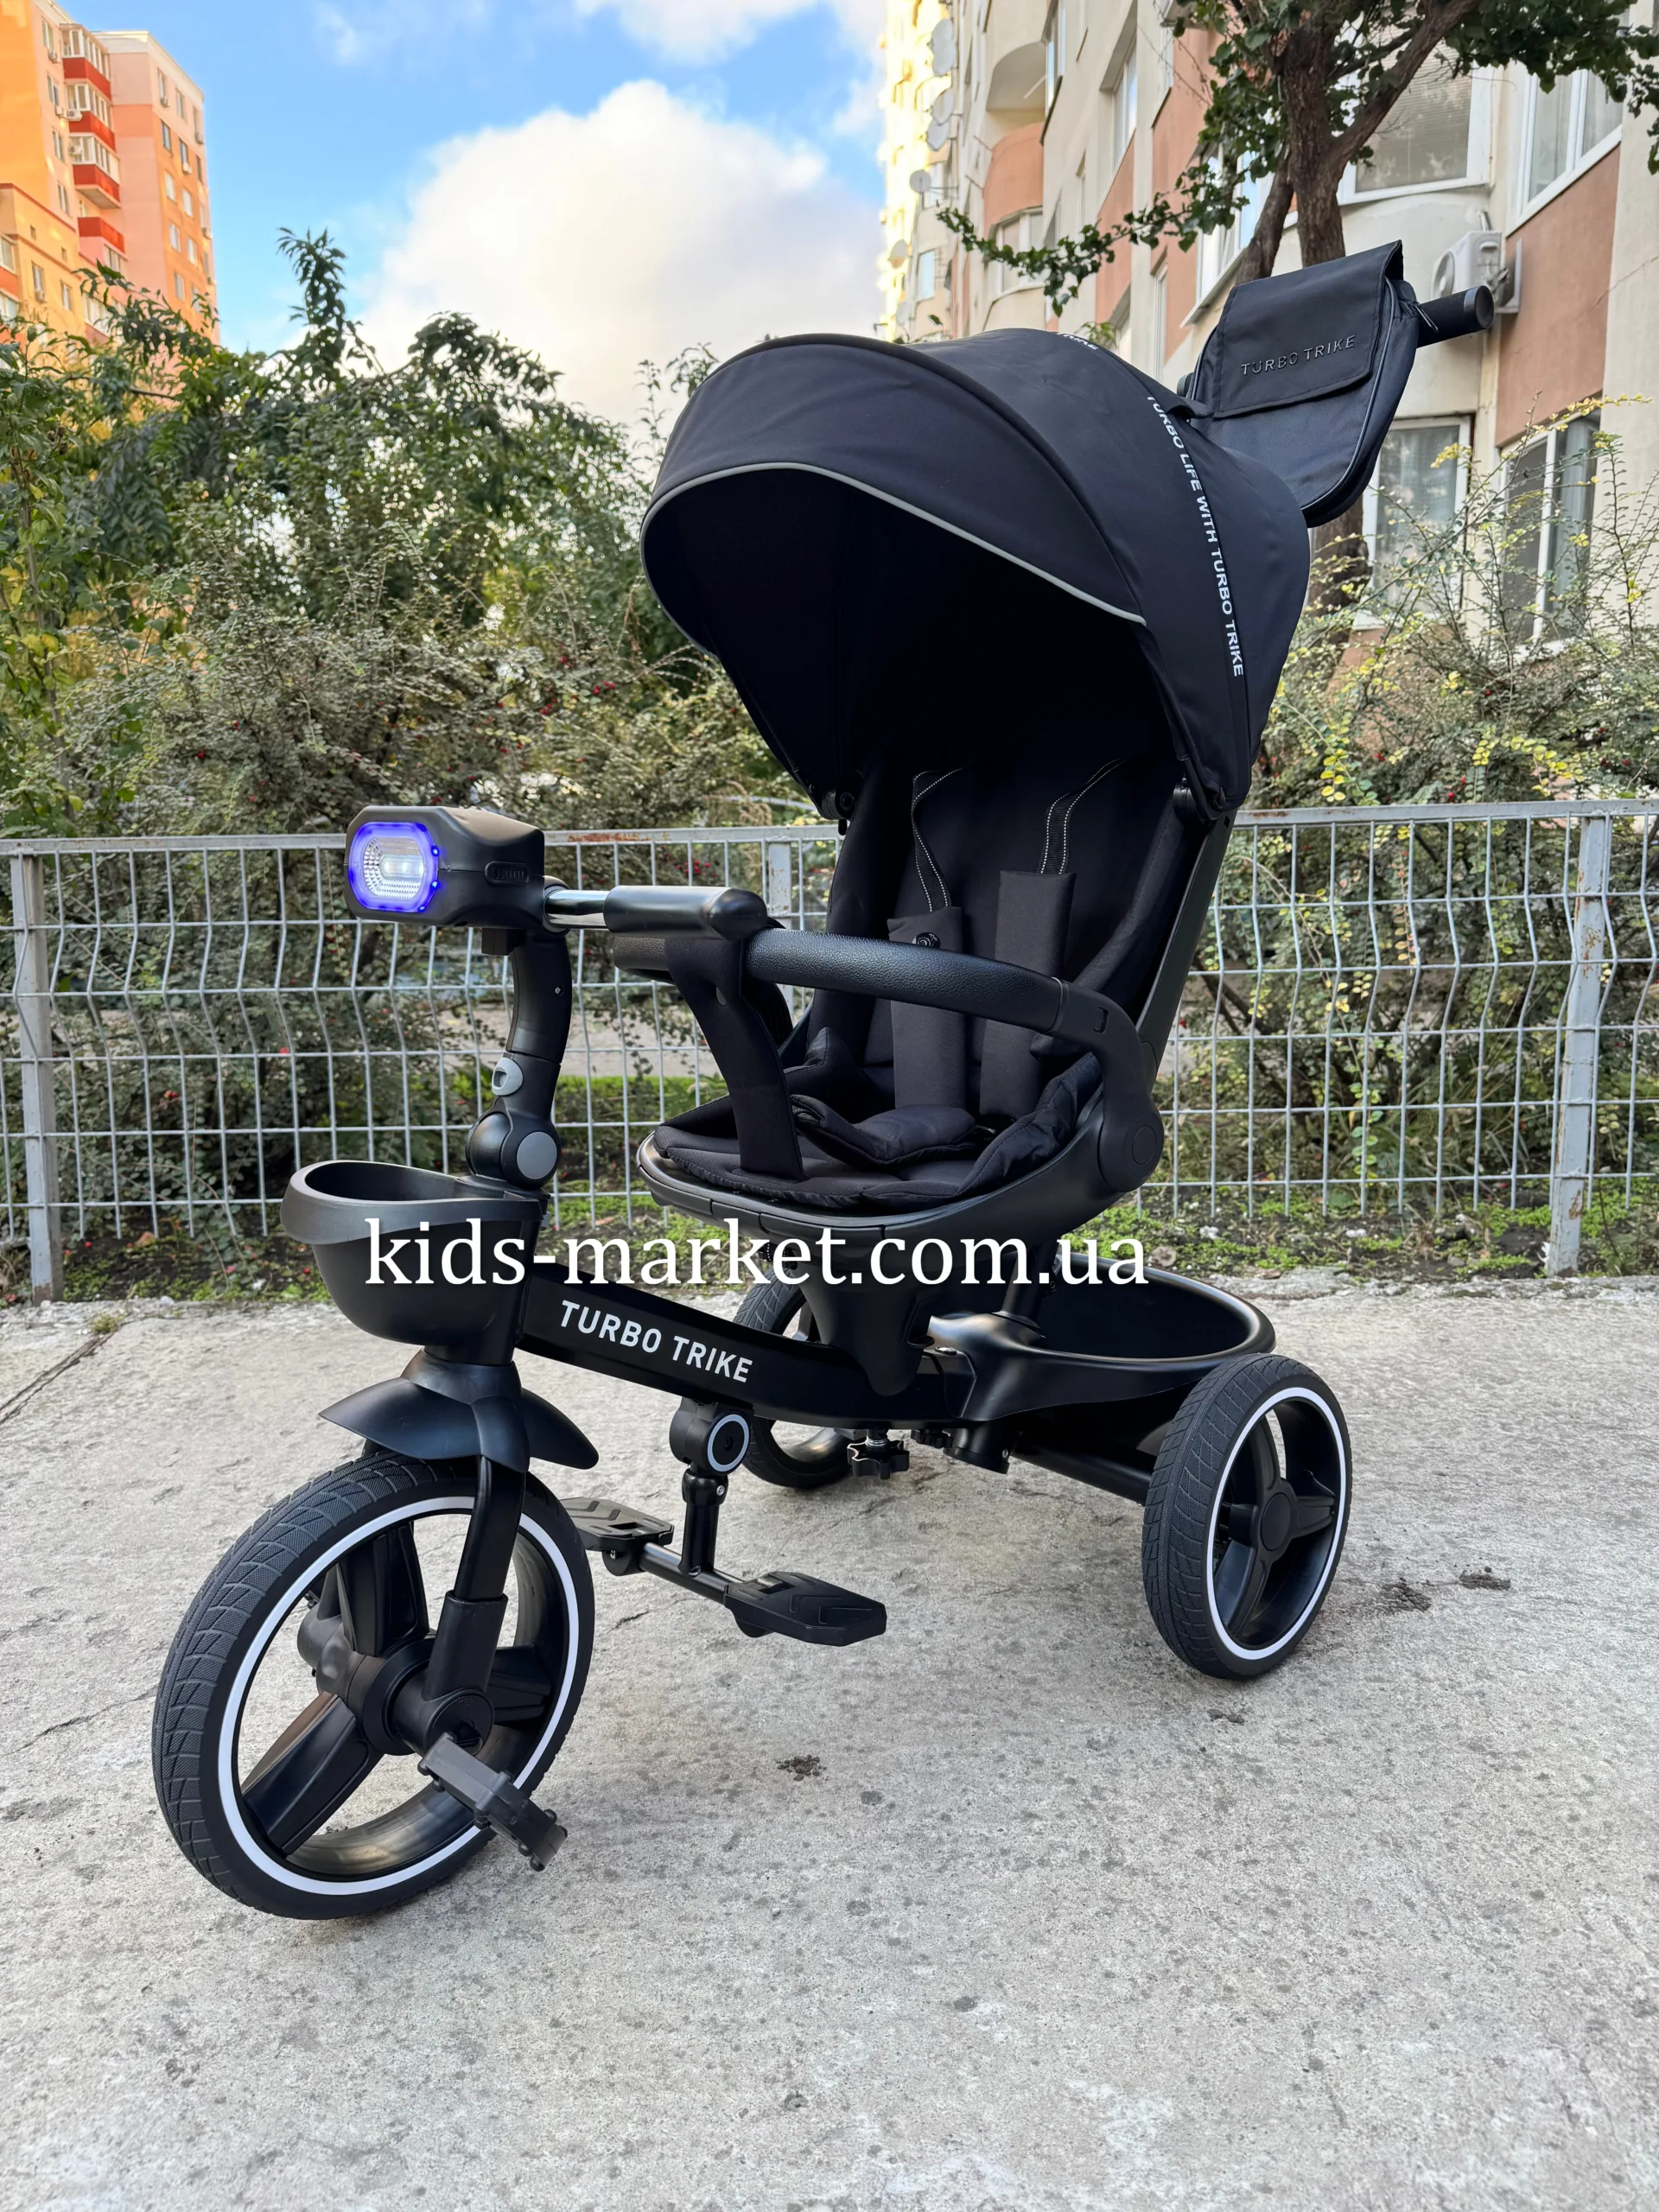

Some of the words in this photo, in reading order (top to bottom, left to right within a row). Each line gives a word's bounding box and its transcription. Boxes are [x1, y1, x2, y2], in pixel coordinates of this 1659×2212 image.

[1241, 352, 1298, 376] TURBO
[1304, 334, 1356, 360] TRIKE
[1179, 454, 1203, 492] LIFE
[1196, 495, 1218, 543] WITH
[1211, 547, 1233, 615] TURBO
[1225, 620, 1244, 677] TRIKE
[560, 1300, 663, 1354] TURBO
[672, 1335, 754, 1383] TRIKE
